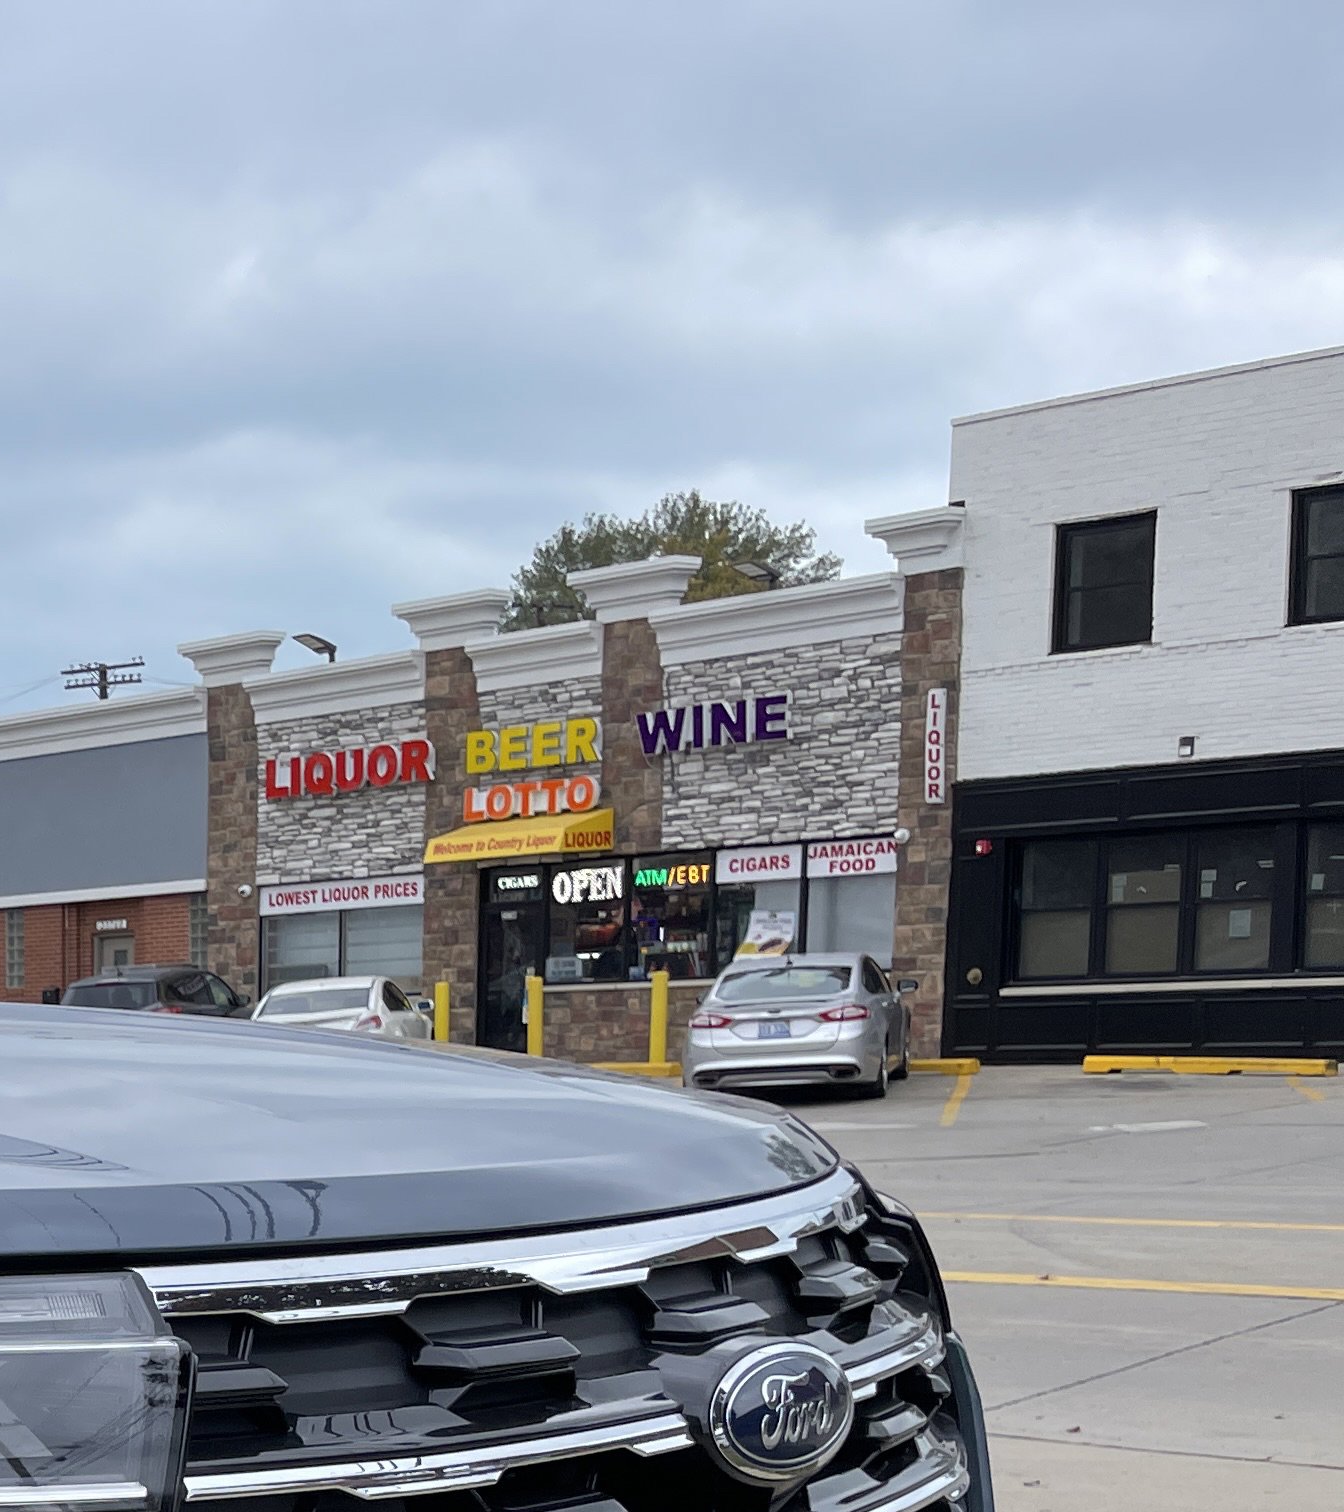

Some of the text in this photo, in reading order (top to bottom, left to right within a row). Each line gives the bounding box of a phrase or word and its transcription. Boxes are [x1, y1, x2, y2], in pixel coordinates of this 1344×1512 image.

[636, 694, 790, 754] WINE
[466, 718, 600, 774] BEER
[928, 693, 941, 799] LIQUOR
[265, 739, 433, 800] LIQUOR
[463, 775, 598, 822] LOTTO
[433, 834, 557, 856] Welcome to Country Liquor
[564, 831, 611, 848] LIQUOR
[808, 840, 898, 859] JAMAICAN
[634, 864, 711, 887] ATM/EBT
[729, 854, 791, 874] CIGARS
[829, 858, 876, 873] FOOD
[269, 882, 418, 907] LOWEST LIQUOR PRICES
[498, 874, 540, 890] CIGARS
[552, 866, 624, 904] OPEN
[761, 1371, 834, 1450] Ford
